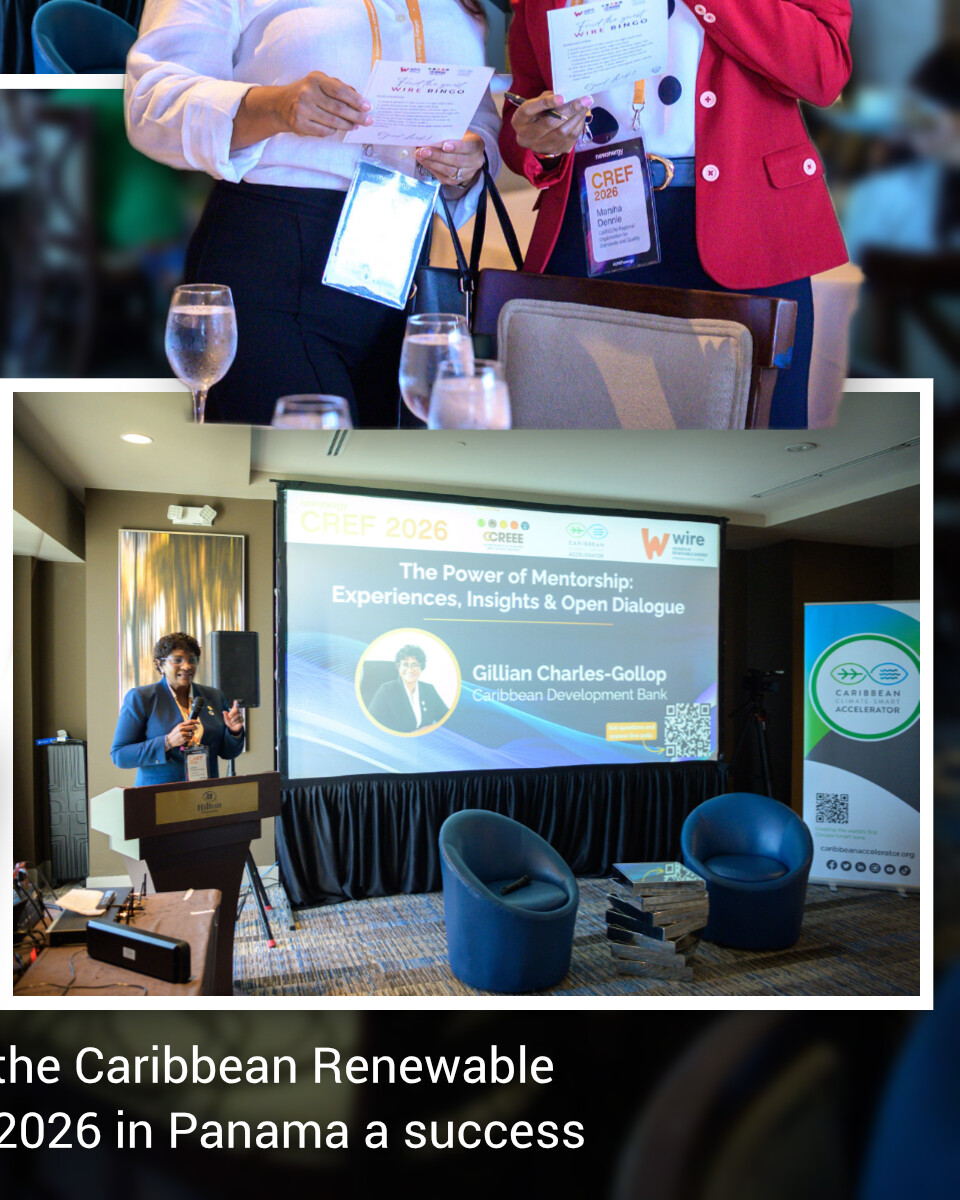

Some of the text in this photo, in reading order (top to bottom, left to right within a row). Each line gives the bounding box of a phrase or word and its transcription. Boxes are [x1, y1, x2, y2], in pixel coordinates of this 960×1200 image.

[574, 18, 648, 38] WIRE BINGO
[391, 86, 421, 94] WIRE
[591, 164, 634, 189] CREF
[594, 186, 619, 202] 2026
[596, 205, 622, 217] Marsha
[597, 216, 622, 228] Dennie
[300, 510, 448, 541] CREF 2026
[672, 531, 705, 547] wire
[399, 562, 634, 593] The Power of Mentorship:
[332, 585, 686, 618] Experiences, Insights & Open Dialogue
[472, 664, 668, 686] Gillian Charles-Gollop
[472, 688, 668, 704] Caribbean Development Bank
[835, 689, 901, 697] CARIBBEAN
[835, 705, 901, 713] ACCELERATOR
[197, 802, 223, 812] Hilton
[820, 844, 916, 860] caribbeanaccelerator.org
